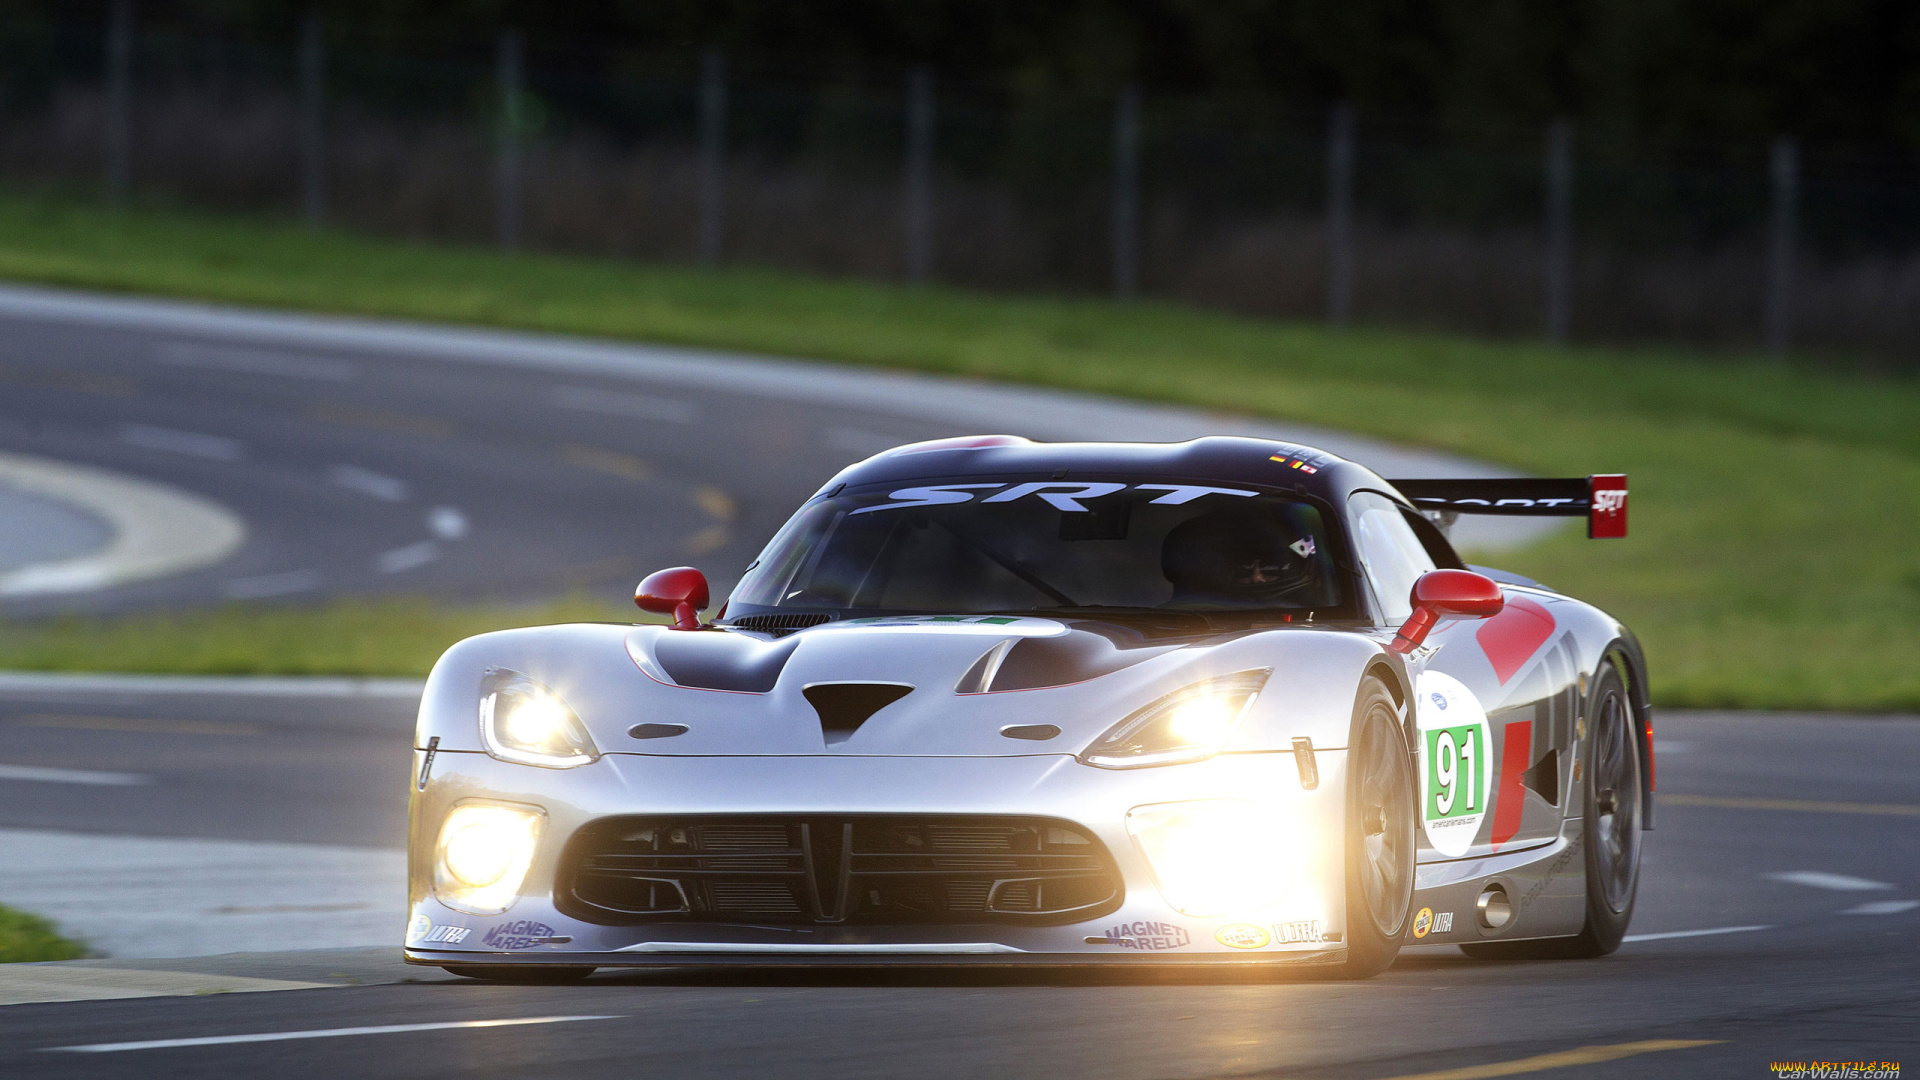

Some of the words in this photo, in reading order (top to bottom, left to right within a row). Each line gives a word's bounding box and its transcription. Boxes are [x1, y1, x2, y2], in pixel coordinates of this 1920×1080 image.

[849, 482, 1260, 515] SRT
[1592, 490, 1629, 510] SRT
[1435, 728, 1476, 816] 91
[425, 924, 472, 944] ULTRA
[1272, 920, 1322, 944] ULTRA
[1431, 912, 1453, 934] ULTRA
